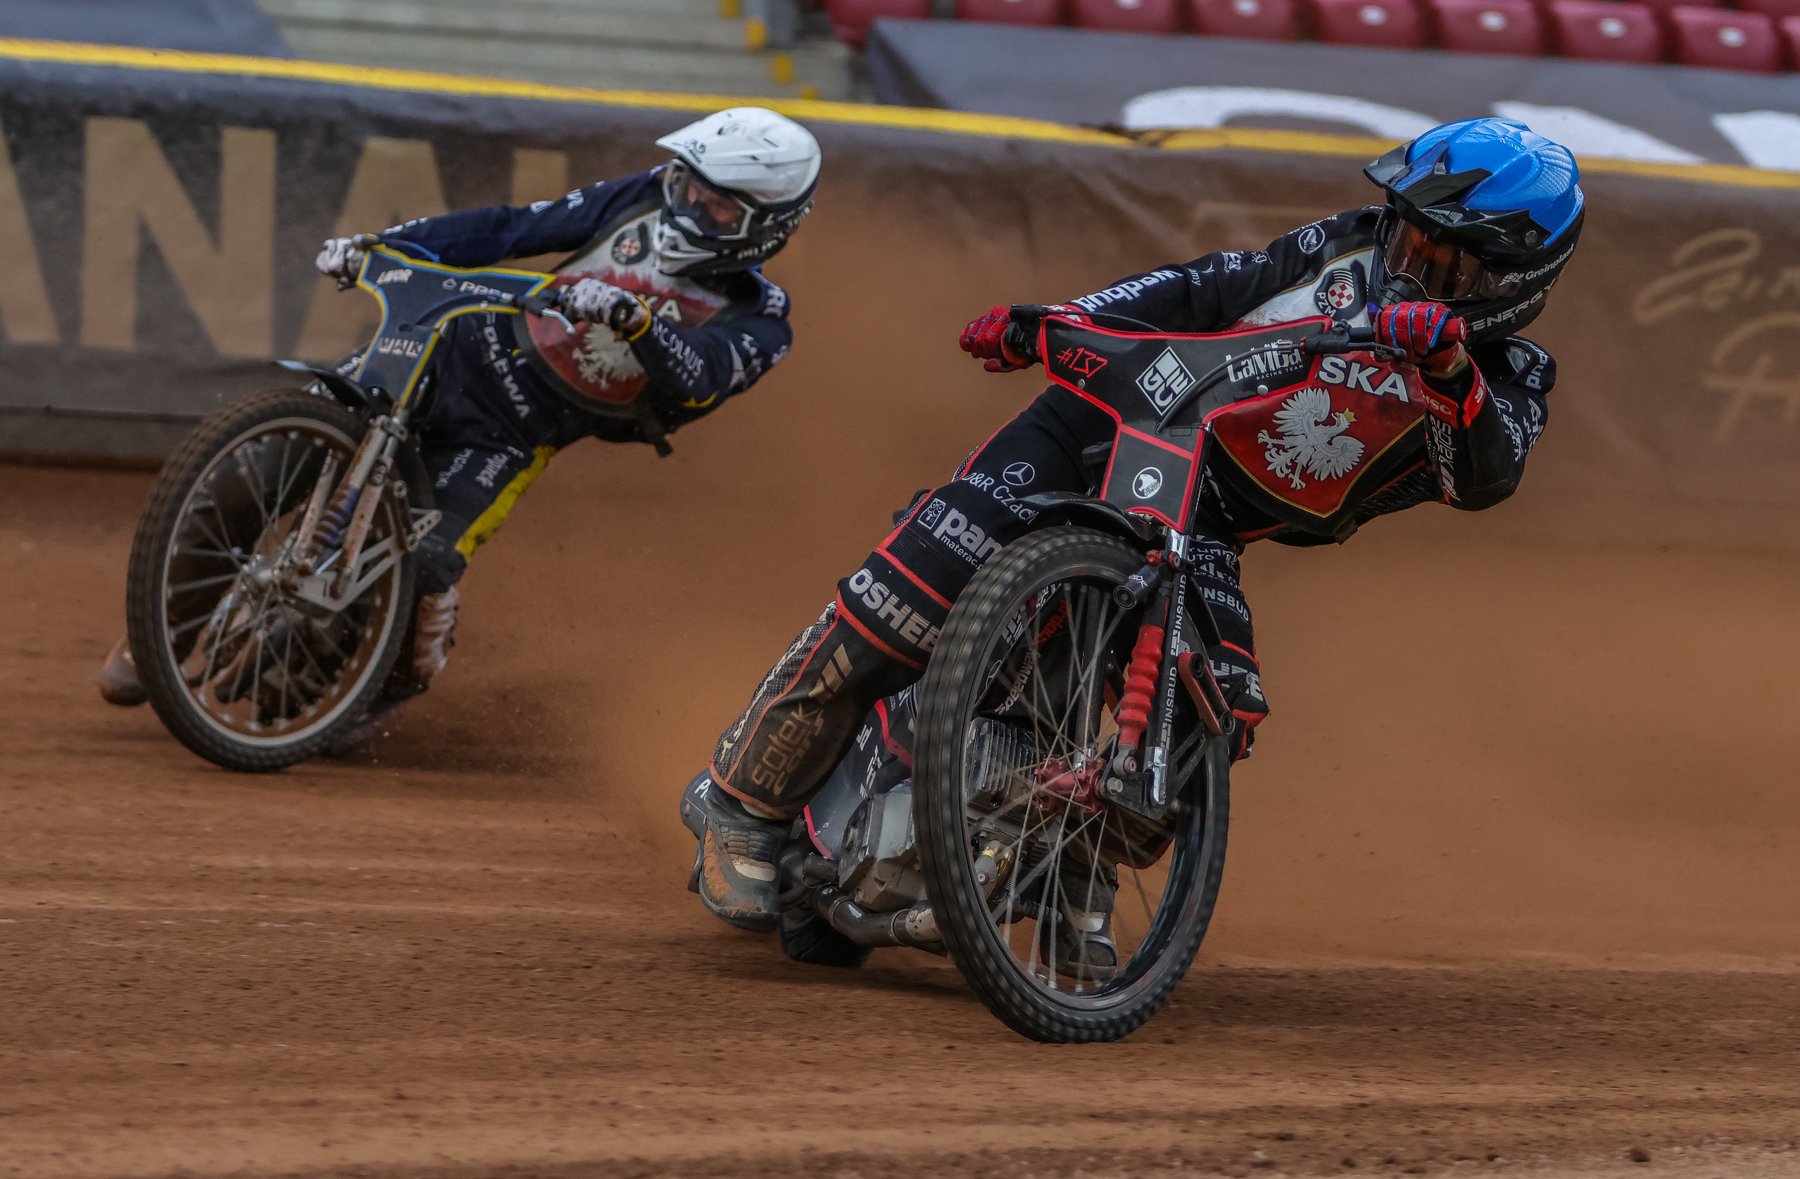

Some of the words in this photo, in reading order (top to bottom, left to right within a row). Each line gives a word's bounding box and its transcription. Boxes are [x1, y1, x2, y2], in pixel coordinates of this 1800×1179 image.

[1525, 243, 1574, 282] Greinplast
[1316, 291, 1337, 318] PZM
[1256, 369, 1283, 381] RACING
[1285, 364, 1304, 375] TEAM
[1318, 357, 1410, 403] SKA
[1174, 574, 1187, 630] INSBUD
[1165, 666, 1177, 723] INSBUD
